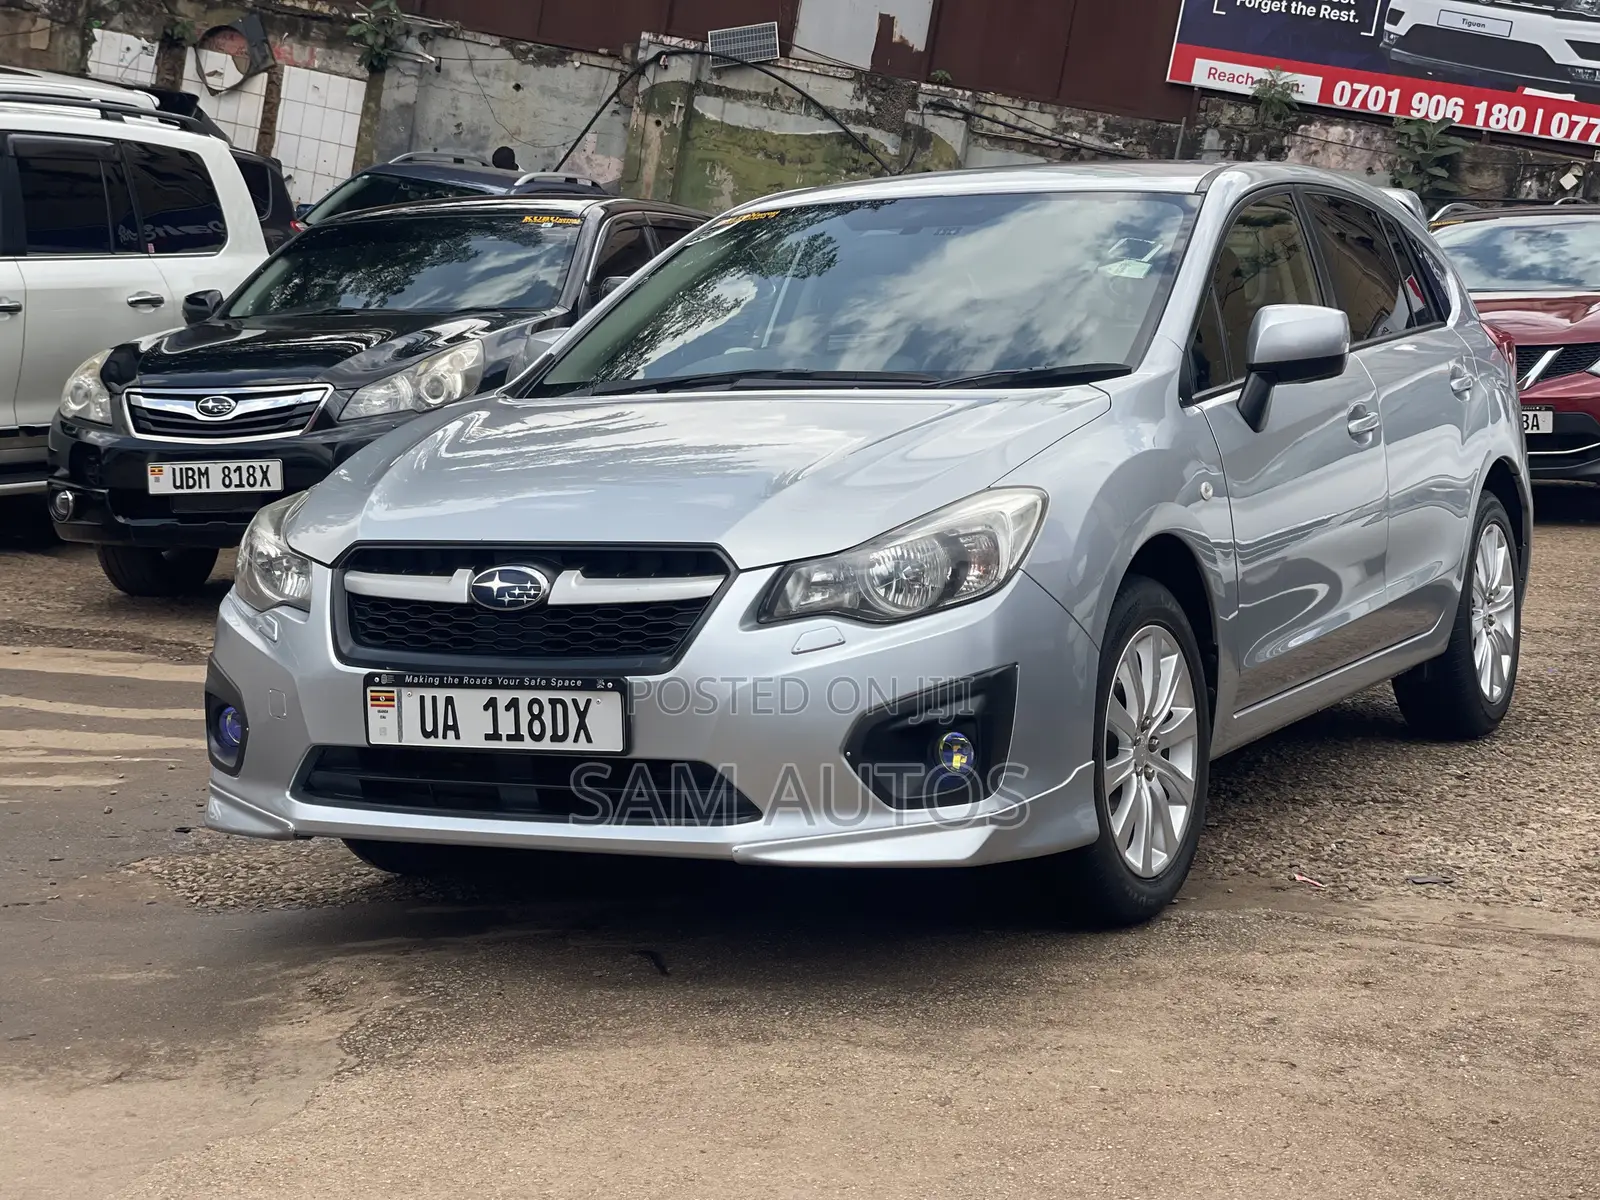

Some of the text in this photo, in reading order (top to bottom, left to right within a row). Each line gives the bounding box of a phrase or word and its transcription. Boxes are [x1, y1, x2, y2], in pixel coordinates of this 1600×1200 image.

[1291, 1, 1316, 16] the
[1319, 5, 1359, 23] Rest.
[1461, 18, 1486, 29] Tiguan
[1207, 66, 1255, 86] Reach
[1333, 81, 1401, 114] 0701
[1410, 92, 1465, 124] 906
[1474, 101, 1527, 132] 180
[1550, 112, 1600, 144] 077
[171, 464, 272, 490] UBM 818X
[404, 675, 440, 686] Making
[443, 676, 459, 684] the
[463, 677, 493, 685] Roads
[497, 677, 520, 685] Your
[524, 677, 547, 686] Safe
[550, 678, 582, 687] Space
[419, 694, 594, 744] UA 118DX
